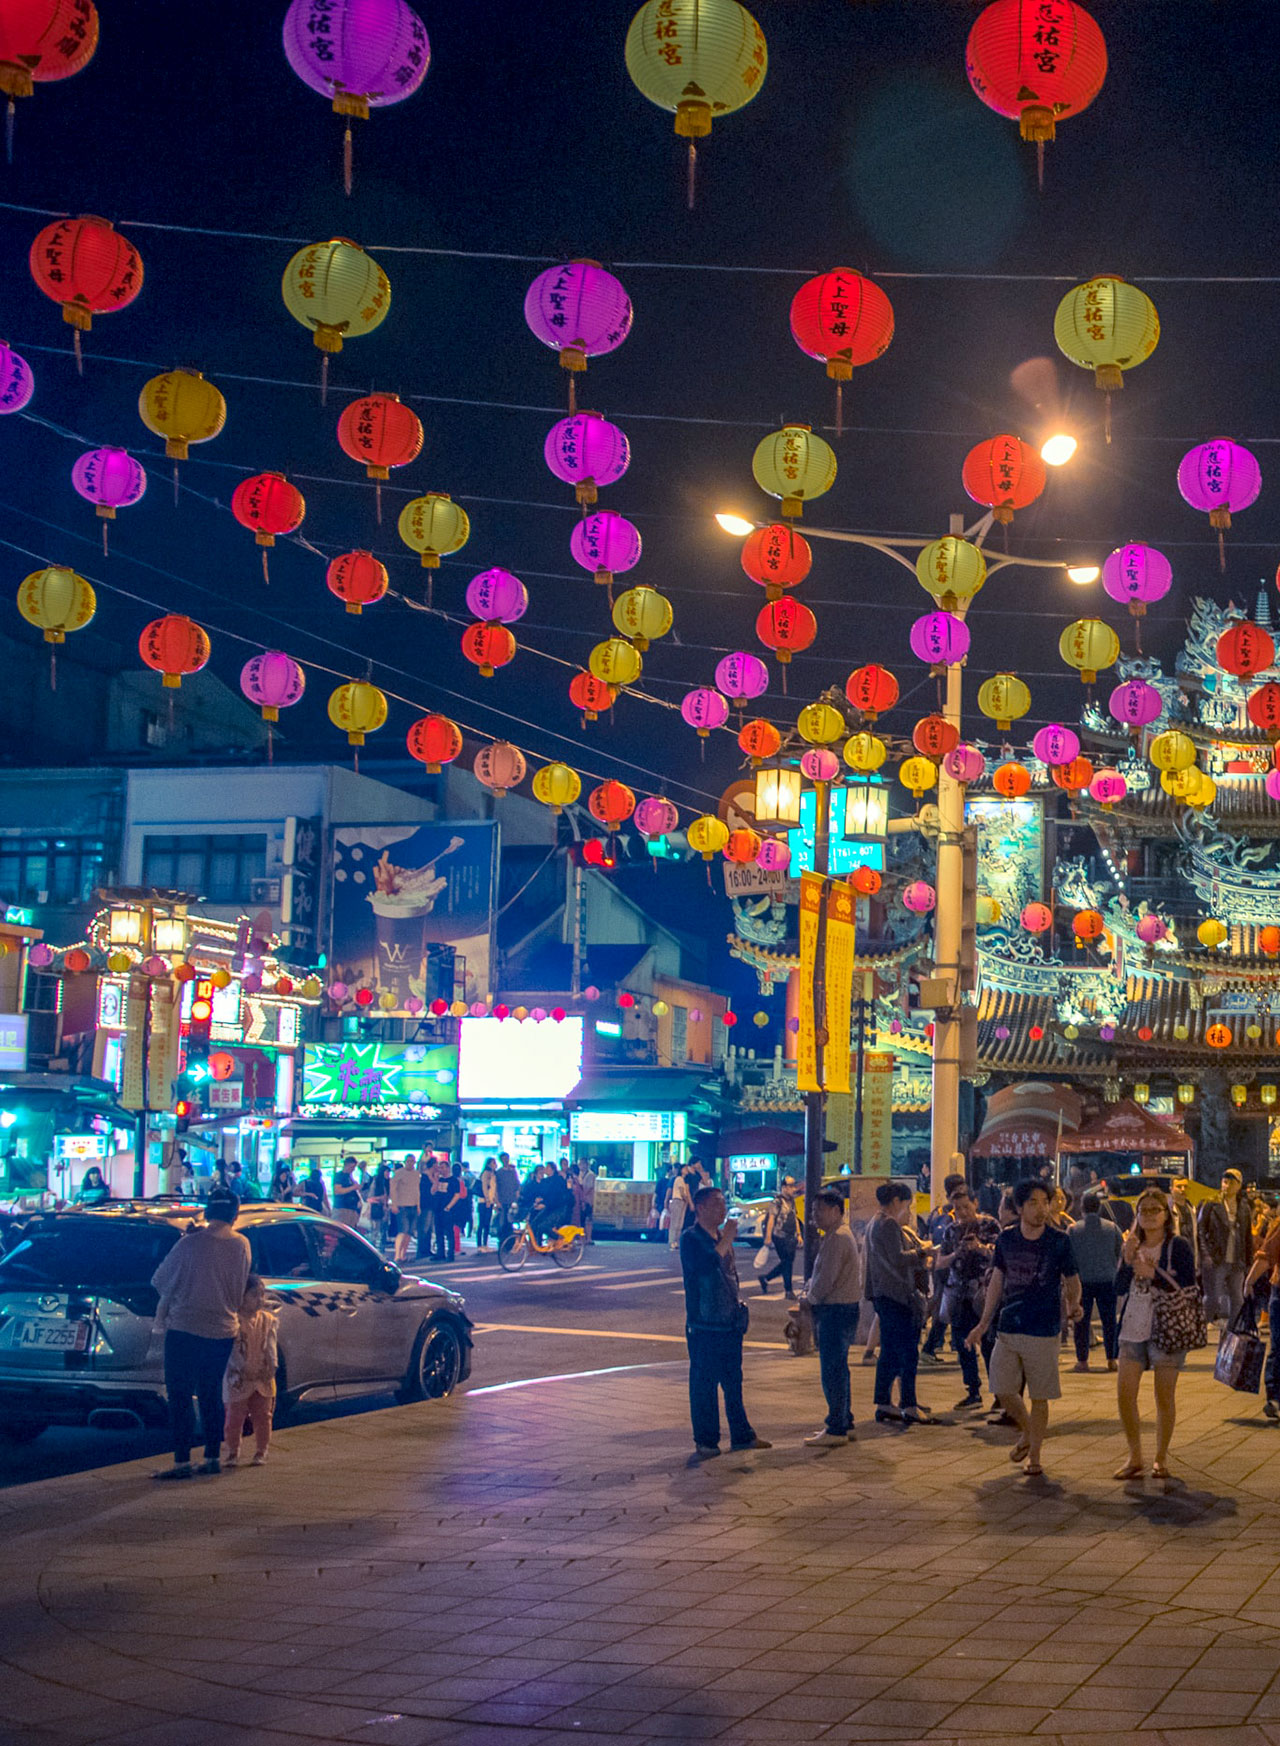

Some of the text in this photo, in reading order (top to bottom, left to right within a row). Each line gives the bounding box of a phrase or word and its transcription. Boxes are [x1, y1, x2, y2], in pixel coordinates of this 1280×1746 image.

[1033, 3, 1063, 75] 慈祐宮
[45, 222, 70, 285] 天上聖母
[551, 265, 577, 328] 天上聖母
[828, 275, 852, 339] 天上聖母
[1083, 290, 1105, 341] 慈祐宮
[782, 438, 799, 481] 慈祐宮
[998, 441, 1016, 492] 天上聖母
[1205, 451, 1222, 493] 慈祐宮
